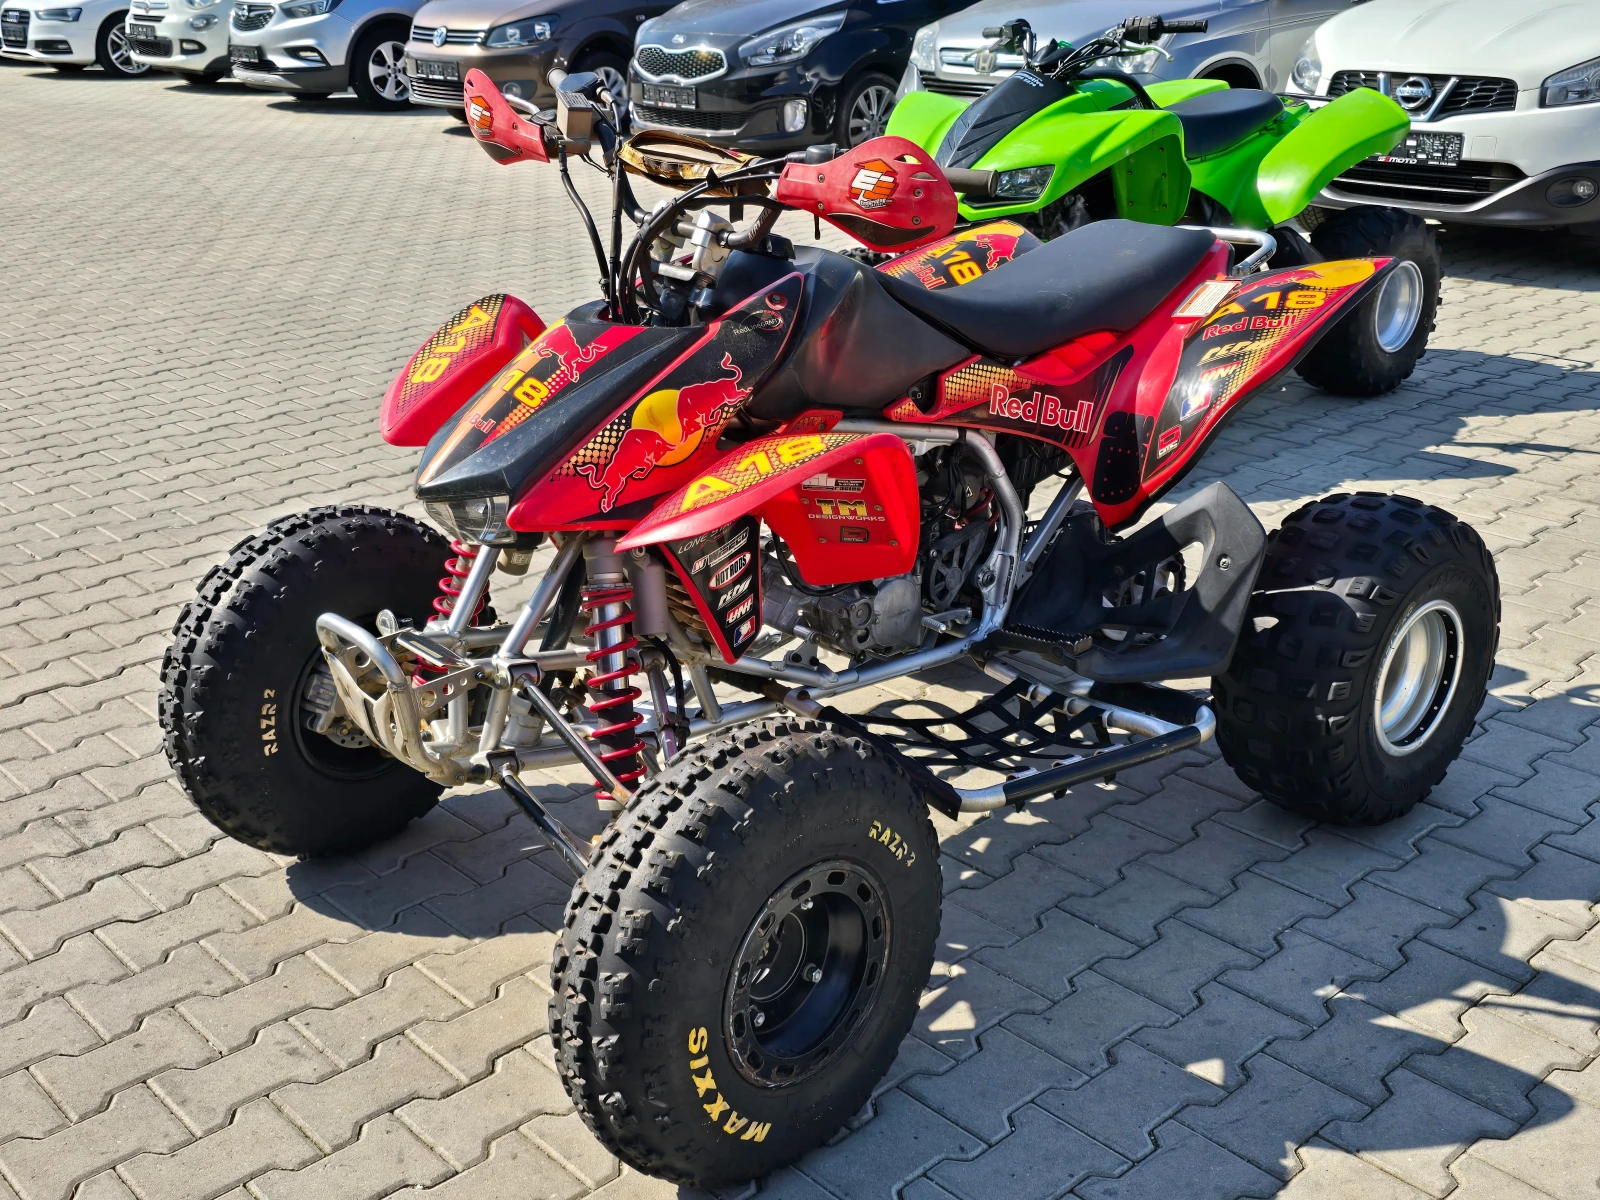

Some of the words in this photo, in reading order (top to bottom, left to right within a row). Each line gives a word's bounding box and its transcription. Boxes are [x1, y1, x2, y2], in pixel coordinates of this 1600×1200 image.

[1202, 316, 1249, 341] Red
[1250, 314, 1297, 330] Bull
[989, 383, 1041, 424] Red
[1041, 394, 1094, 433] Bull
[469, 412, 497, 434] Bull
[808, 513, 886, 521] DESIGNWORKS
[815, 499, 868, 516] TM
[715, 567, 730, 587] HOT
[730, 554, 747, 579] RODS
[687, 1026, 772, 1142] MAXXIS
